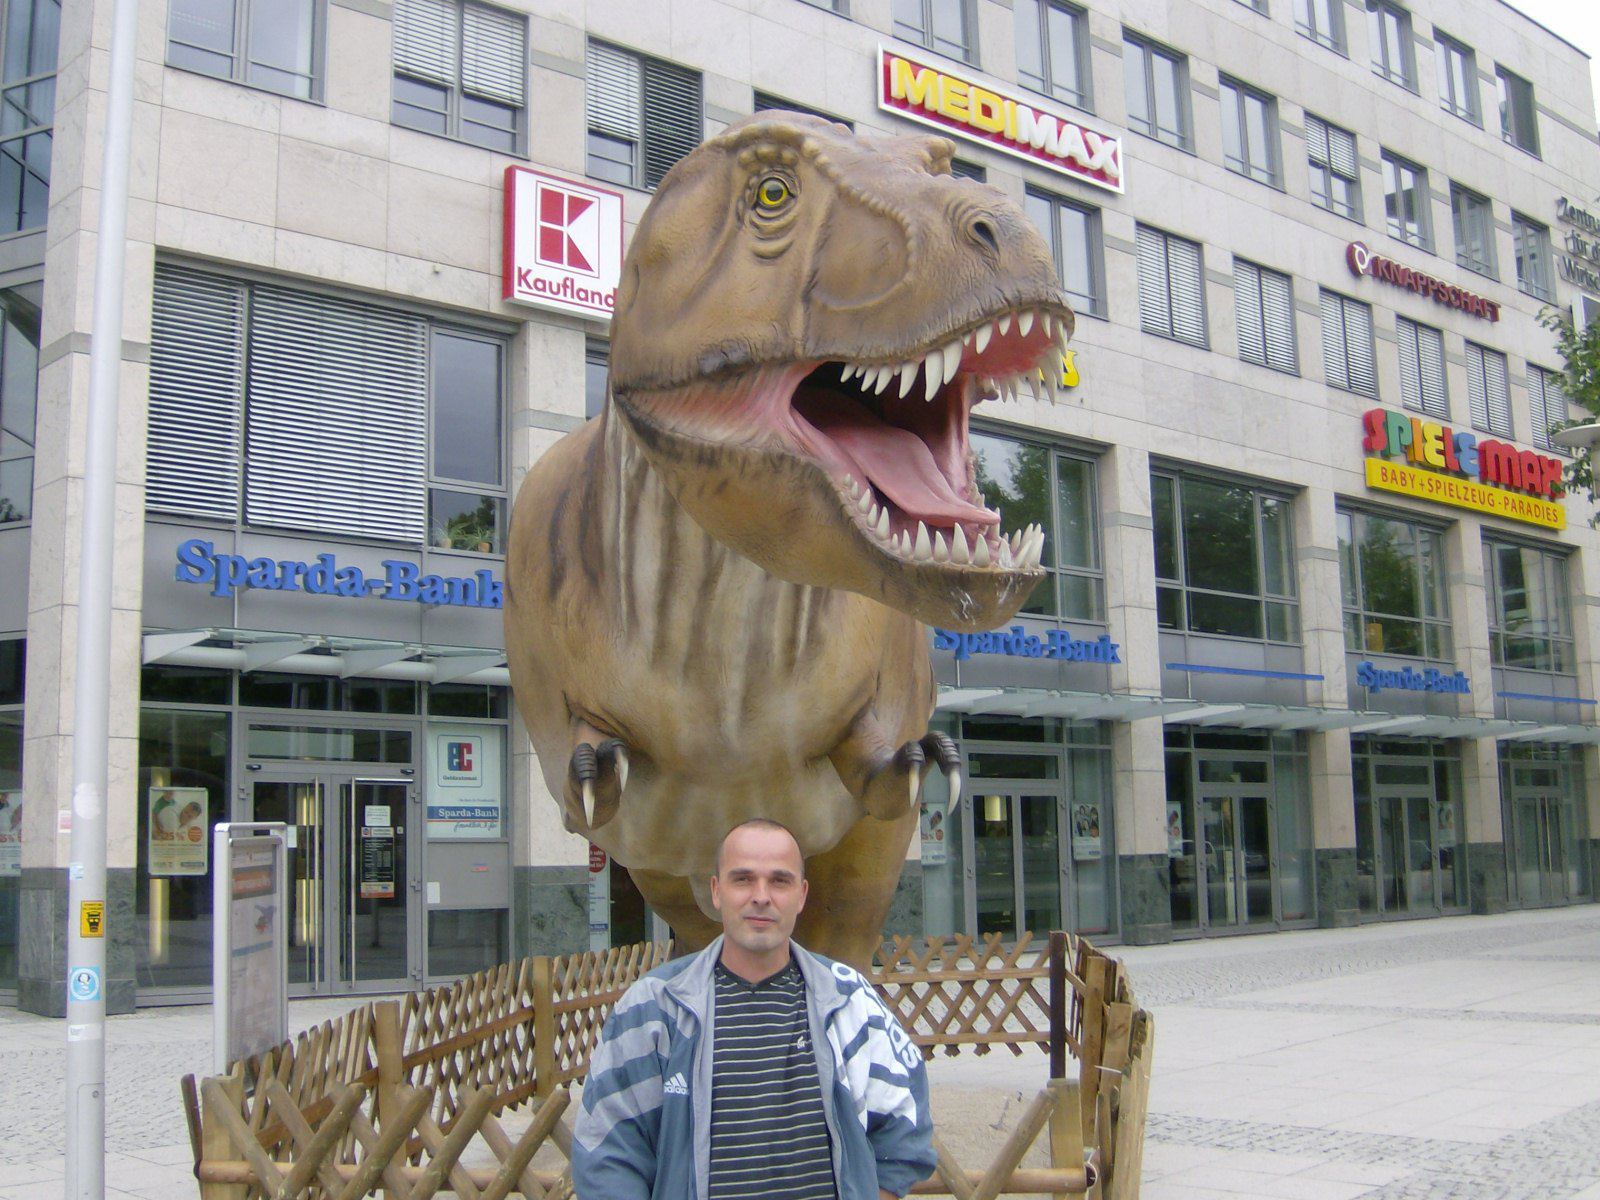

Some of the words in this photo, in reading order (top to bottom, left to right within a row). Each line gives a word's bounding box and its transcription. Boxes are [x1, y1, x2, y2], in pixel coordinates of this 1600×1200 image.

[890, 57, 1120, 178] MEDIMAX
[517, 266, 618, 307] Kaufland
[1372, 256, 1501, 322] KNAPPSCHAFT
[176, 538, 503, 608] Sparda-Bank
[934, 626, 1121, 664] Sparda-Bank
[1356, 661, 1471, 694] Sparda-Bank
[438, 808, 498, 819] Sparda-Bank
[831, 962, 923, 1069] adas
